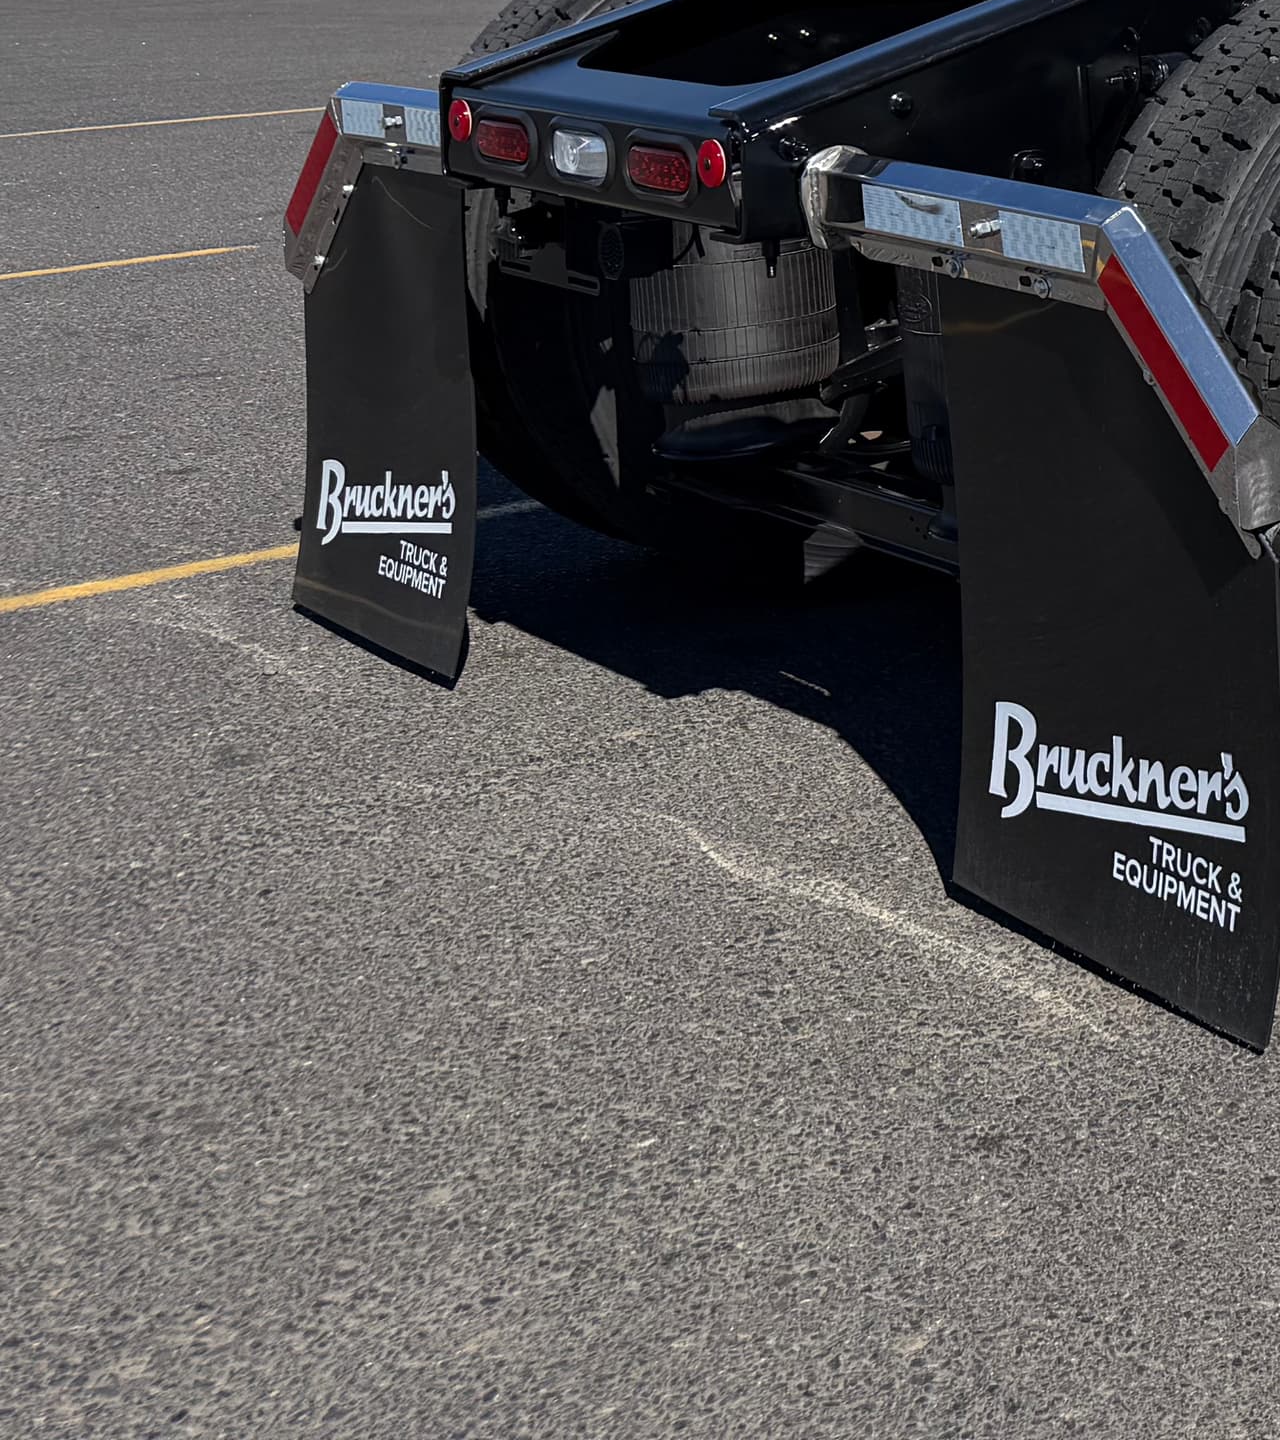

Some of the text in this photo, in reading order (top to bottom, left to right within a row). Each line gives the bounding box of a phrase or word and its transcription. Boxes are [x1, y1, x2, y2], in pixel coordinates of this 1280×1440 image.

[316, 459, 456, 545] Bruckner's
[378, 555, 446, 599] EQUIPMENT
[400, 540, 448, 576] TRUCK &
[988, 701, 1250, 820] Bruckner's
[1112, 852, 1241, 932] EQUIPMENT
[1149, 836, 1243, 902] TRUCK &
